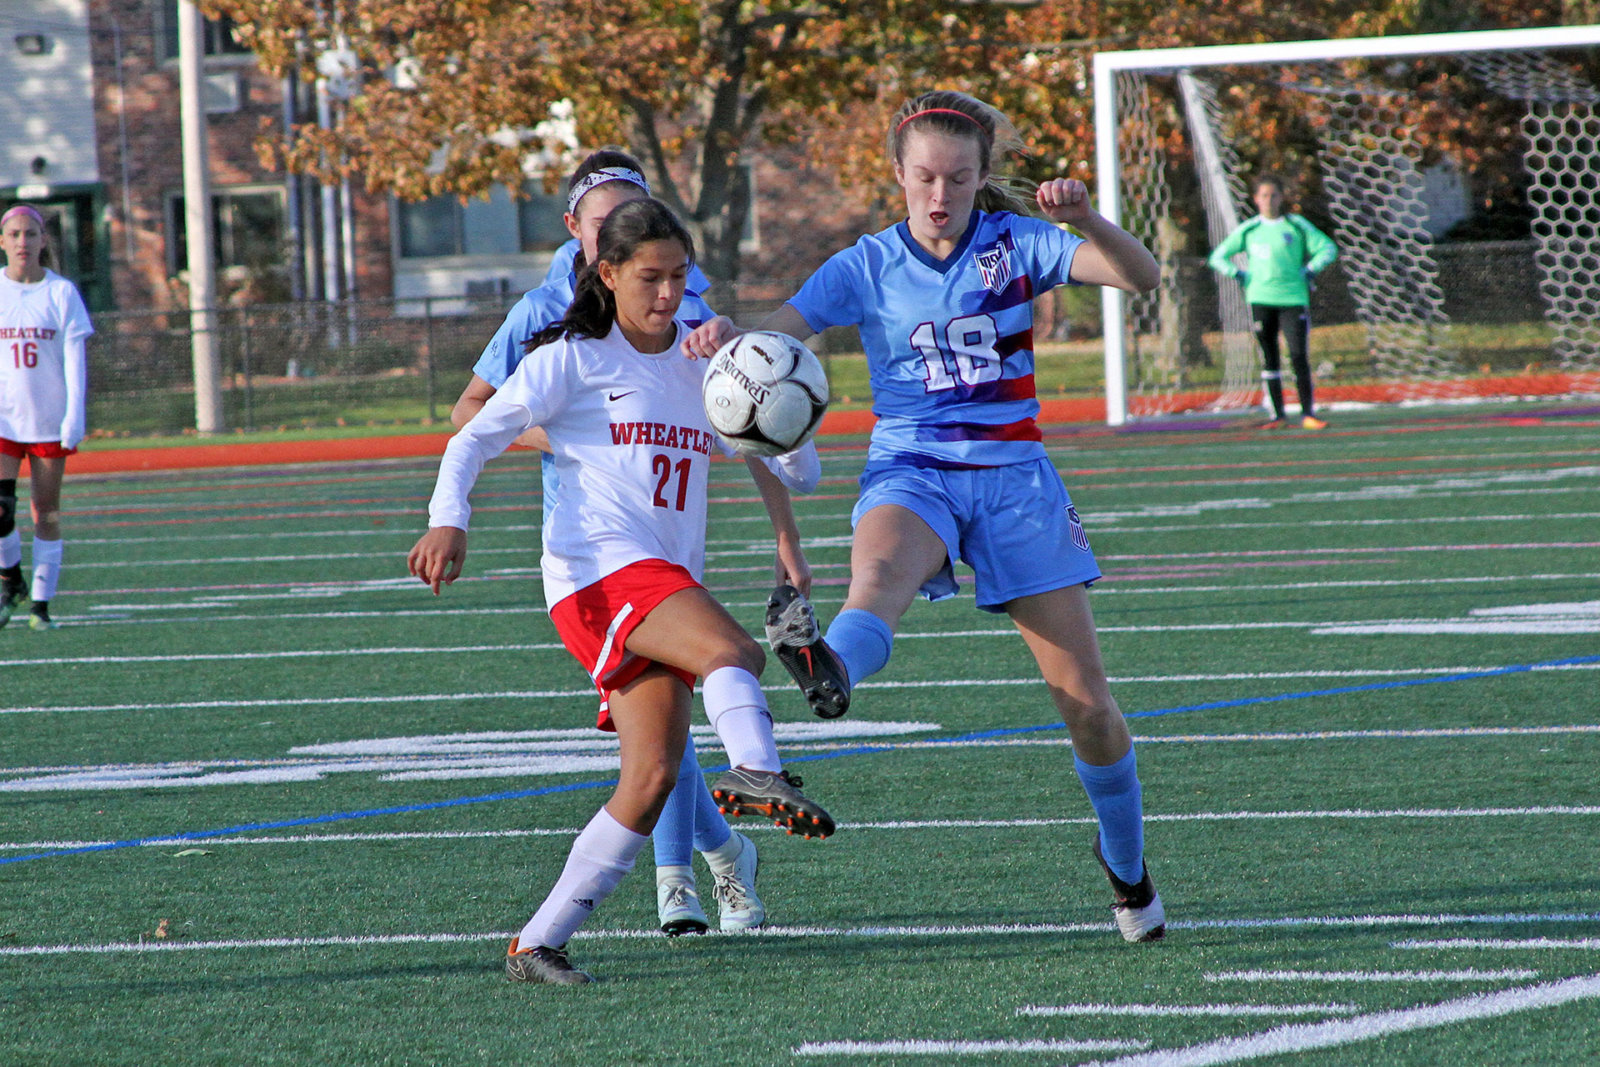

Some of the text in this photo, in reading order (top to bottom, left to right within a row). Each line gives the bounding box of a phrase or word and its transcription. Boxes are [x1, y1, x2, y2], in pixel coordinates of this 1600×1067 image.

[0, 328, 56, 340] HEATLEY
[10, 341, 38, 369] 16
[910, 312, 1003, 394] 18
[717, 353, 770, 404] SPALDING
[609, 422, 712, 456] WHEATLE
[652, 453, 692, 512] 21
